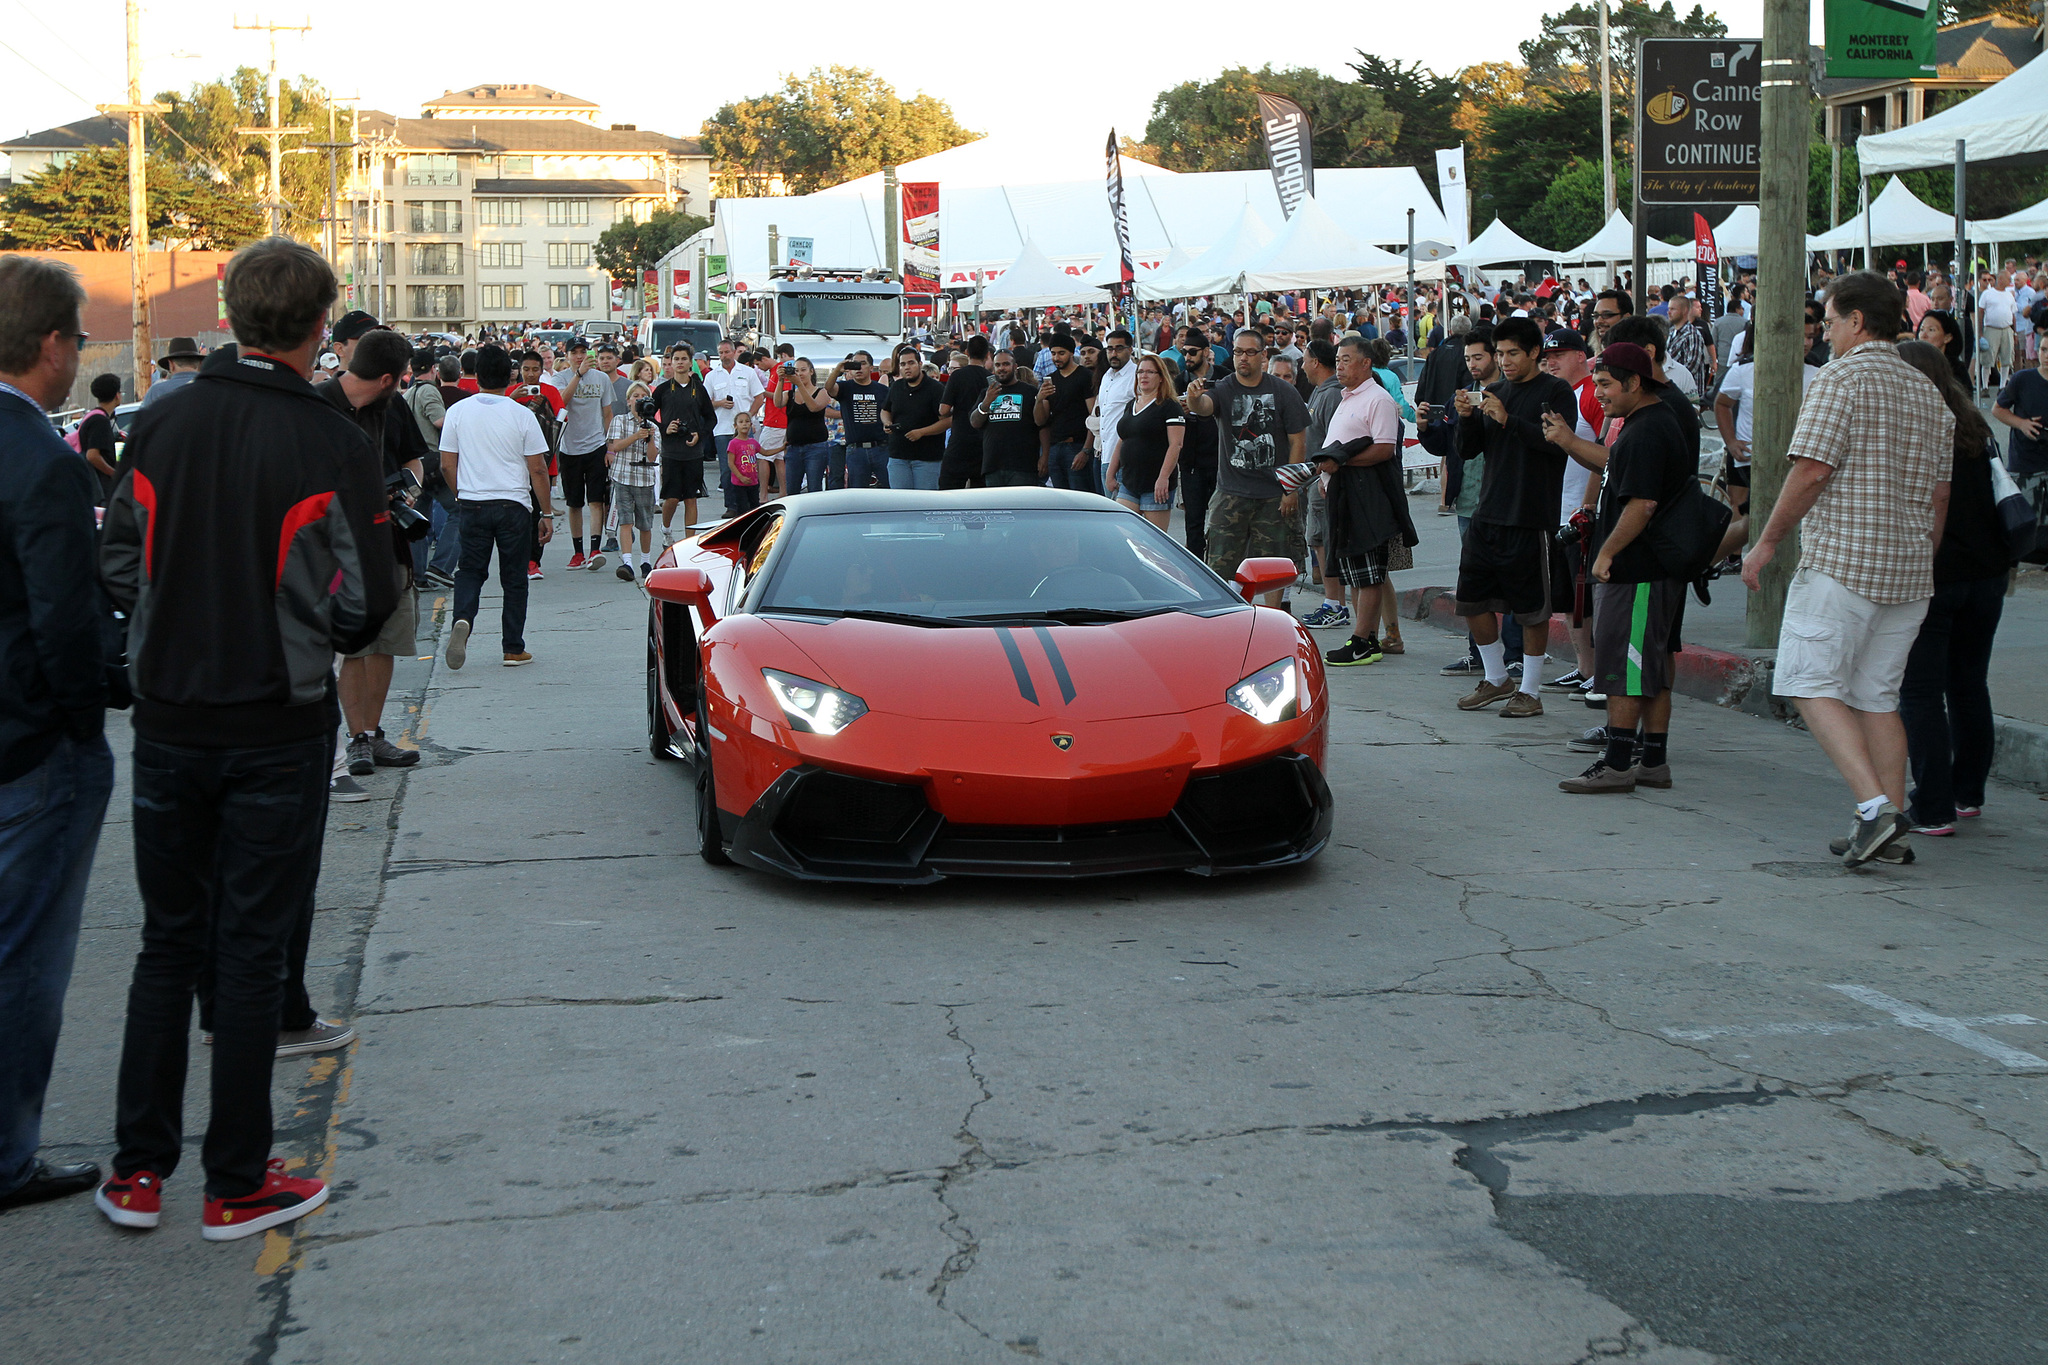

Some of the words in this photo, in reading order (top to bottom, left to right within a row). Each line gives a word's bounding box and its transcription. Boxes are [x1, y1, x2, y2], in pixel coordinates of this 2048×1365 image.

[1849, 35, 1909, 45] MONTEREY
[1846, 48, 1913, 60] CALIFORNIA
[1693, 79, 1762, 102] Canne
[1695, 108, 1742, 131] Row
[1643, 180, 1665, 190] The
[1669, 180, 1690, 194] City
[1694, 180, 1707, 194] of
[1707, 180, 1756, 194] Monterey
[794, 249, 806, 257] ROW
[950, 269, 1006, 283] AUT
